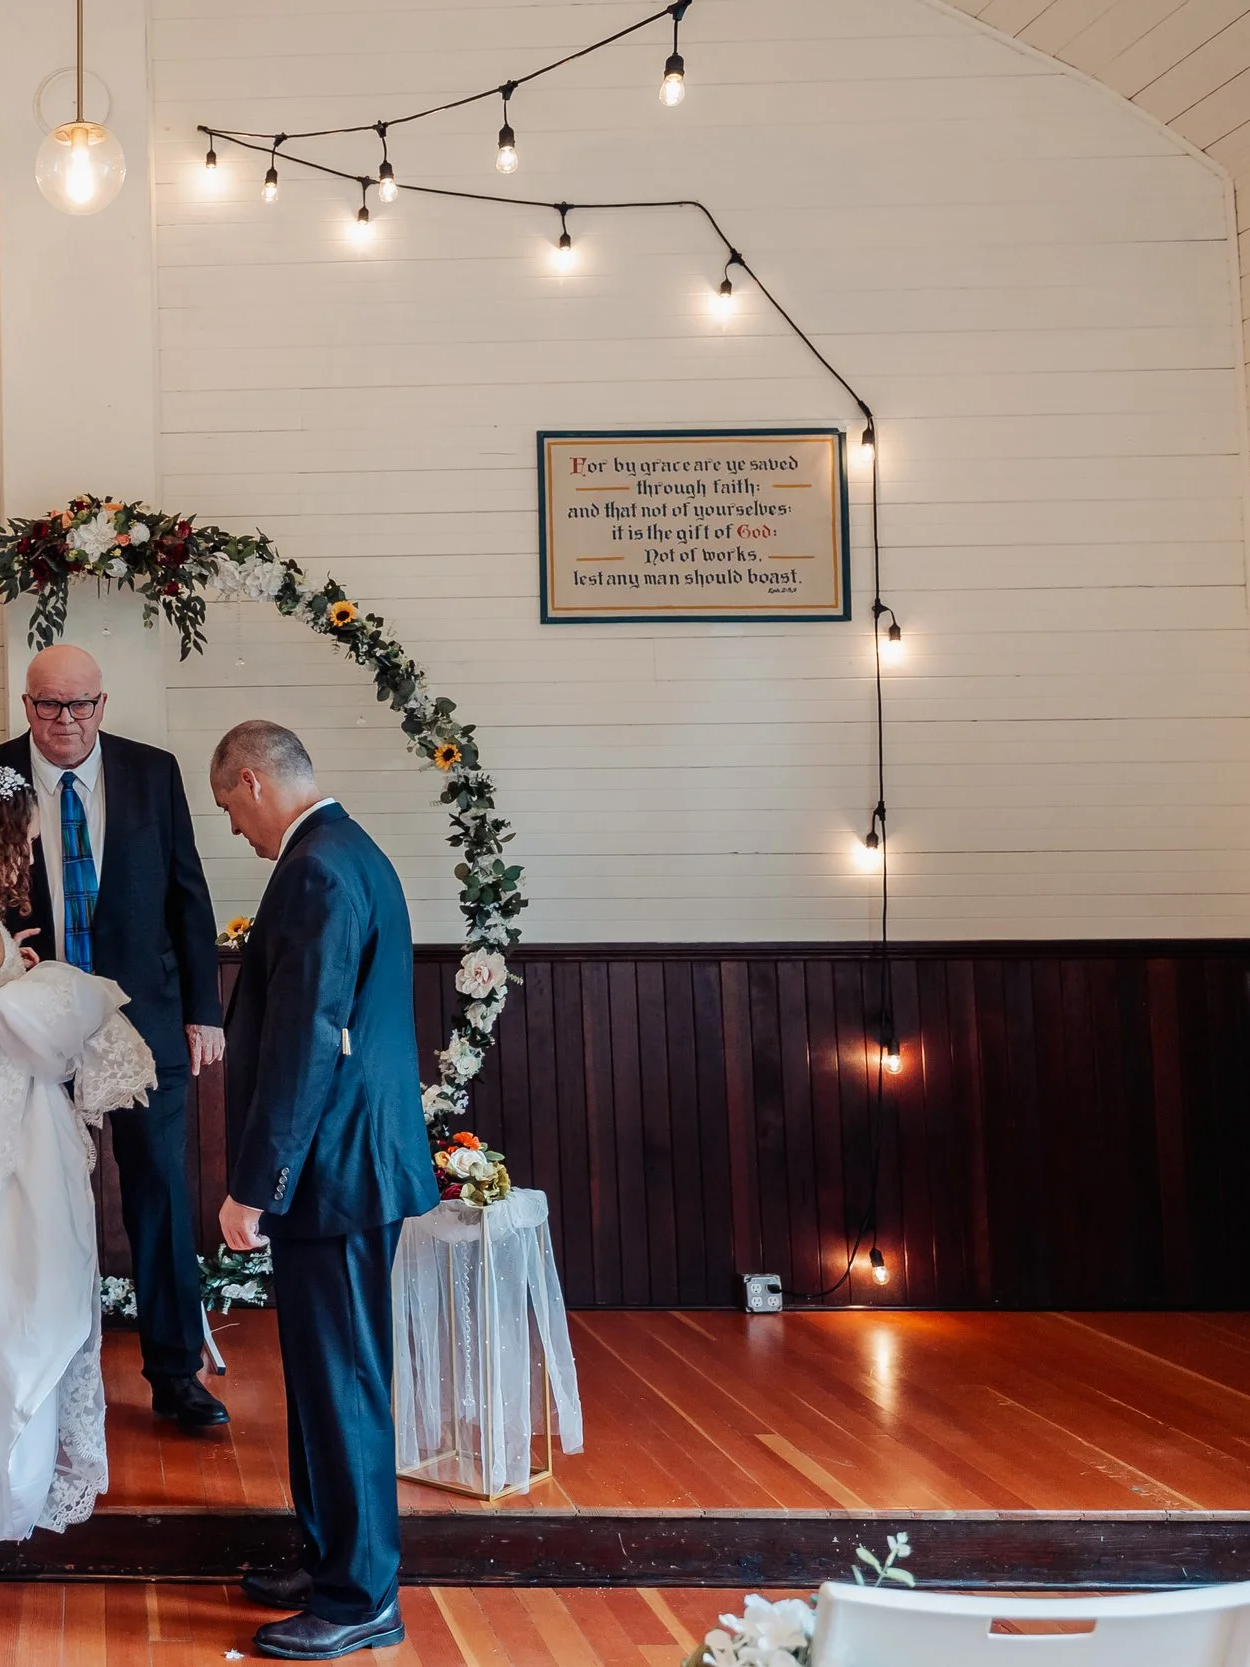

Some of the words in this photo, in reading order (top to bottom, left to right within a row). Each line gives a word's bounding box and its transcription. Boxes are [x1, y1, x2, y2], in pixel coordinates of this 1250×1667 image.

[569, 457, 607, 477] For
[614, 457, 636, 477] by
[640, 458, 690, 476] grace
[694, 458, 721, 472] are
[726, 459, 746, 476] ye
[750, 455, 798, 471] saved
[637, 480, 705, 499] through
[713, 479, 761, 497] faith:
[568, 504, 599, 519] and
[604, 502, 637, 520] that
[641, 503, 667, 518] not
[672, 502, 691, 517] of
[694, 501, 792, 521] yourselves:
[611, 526, 623, 540] it
[628, 526, 643, 540] is
[647, 524, 671, 543] the
[676, 523, 709, 544] gift
[714, 523, 733, 539] of
[737, 524, 777, 539] God:
[644, 549, 675, 564] Not
[680, 548, 697, 562] of
[574, 570, 603, 586] lest
[606, 572, 640, 588] any
[644, 571, 679, 585] man
[684, 570, 742, 587] should
[748, 568, 802, 584] boast.
